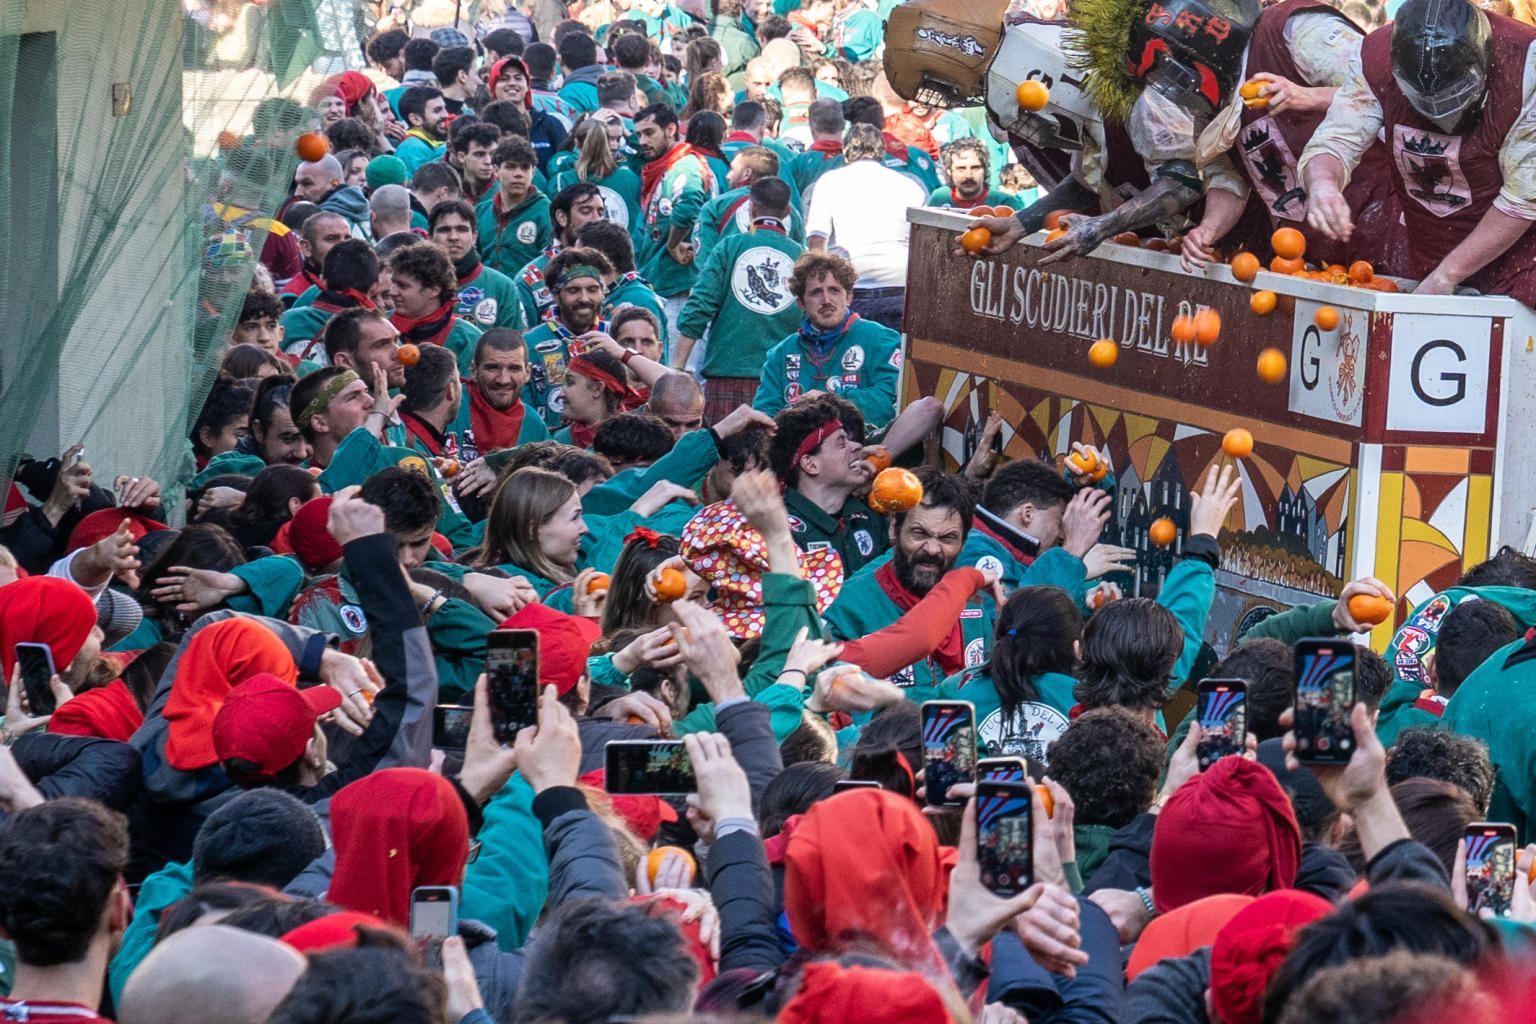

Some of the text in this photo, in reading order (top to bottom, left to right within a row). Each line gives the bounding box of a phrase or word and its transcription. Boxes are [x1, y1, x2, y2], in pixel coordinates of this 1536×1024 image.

[970, 260, 1009, 321] GLI
[1010, 266, 1118, 342] SCUDIERI
[1121, 288, 1169, 357] DEL
[1301, 324, 1321, 391] G
[1410, 339, 1467, 407] G
